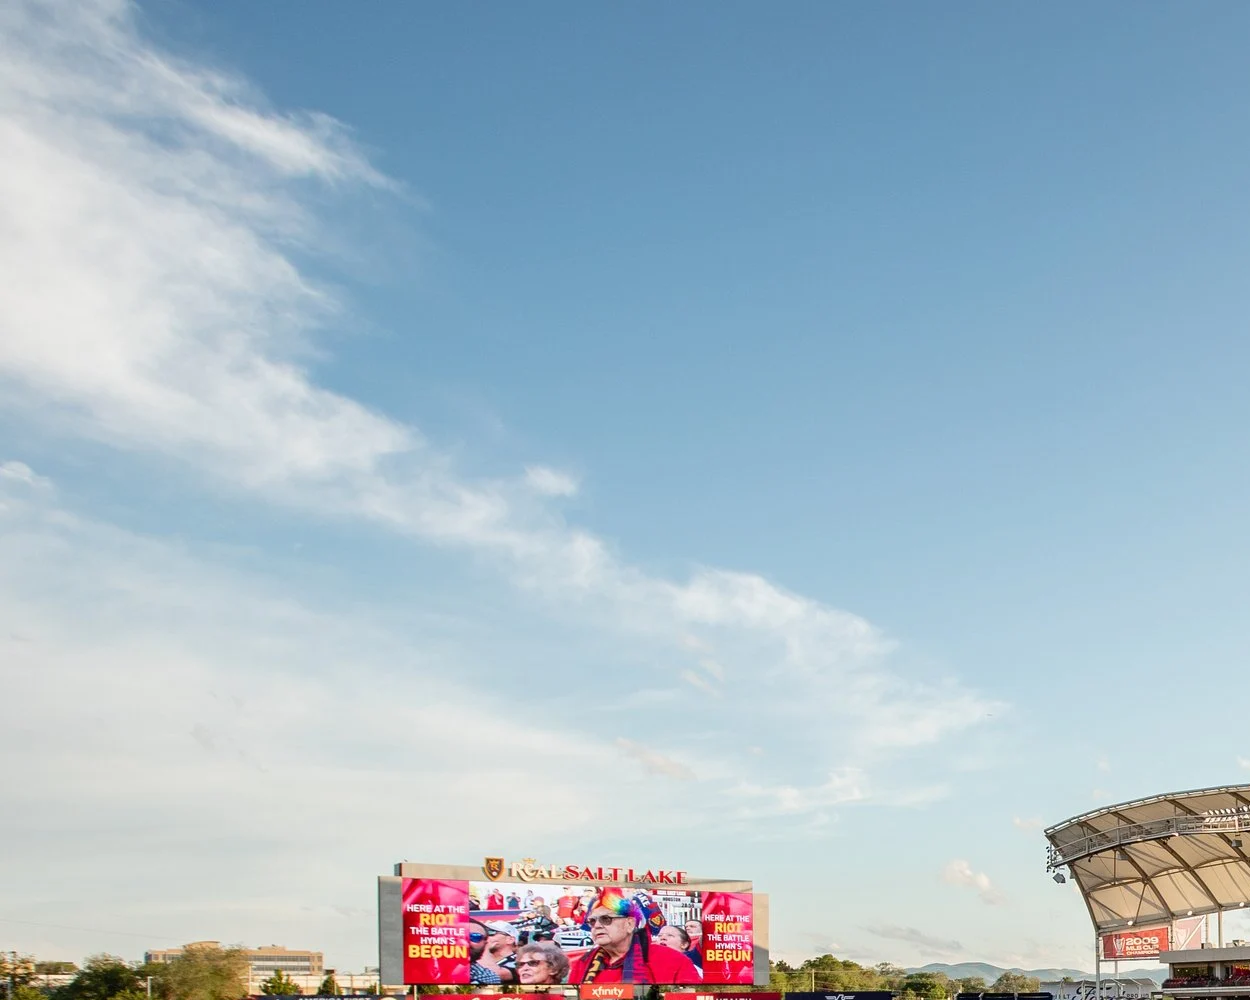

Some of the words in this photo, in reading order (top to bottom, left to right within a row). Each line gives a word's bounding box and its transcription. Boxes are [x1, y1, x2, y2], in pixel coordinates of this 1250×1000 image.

[564, 865, 623, 882] SALT
[627, 868, 689, 885] LAKE
[406, 904, 433, 913] HERE
[434, 904, 446, 913] AT
[447, 905, 466, 914] THE
[419, 913, 456, 926] RIOT
[704, 914, 724, 922] HERE
[736, 915, 750, 923] THE
[409, 926, 430, 936] THE
[430, 927, 466, 937] BATTLE
[714, 922, 742, 933] RIOT
[420, 936, 456, 945] HYMN'S
[723, 934, 750, 942] BATTLE
[1125, 936, 1159, 946] 2009
[408, 944, 468, 959] BEGUN
[715, 942, 743, 950] HYMN'S
[706, 949, 751, 962] BEGUN
[592, 987, 624, 998] xfinity
